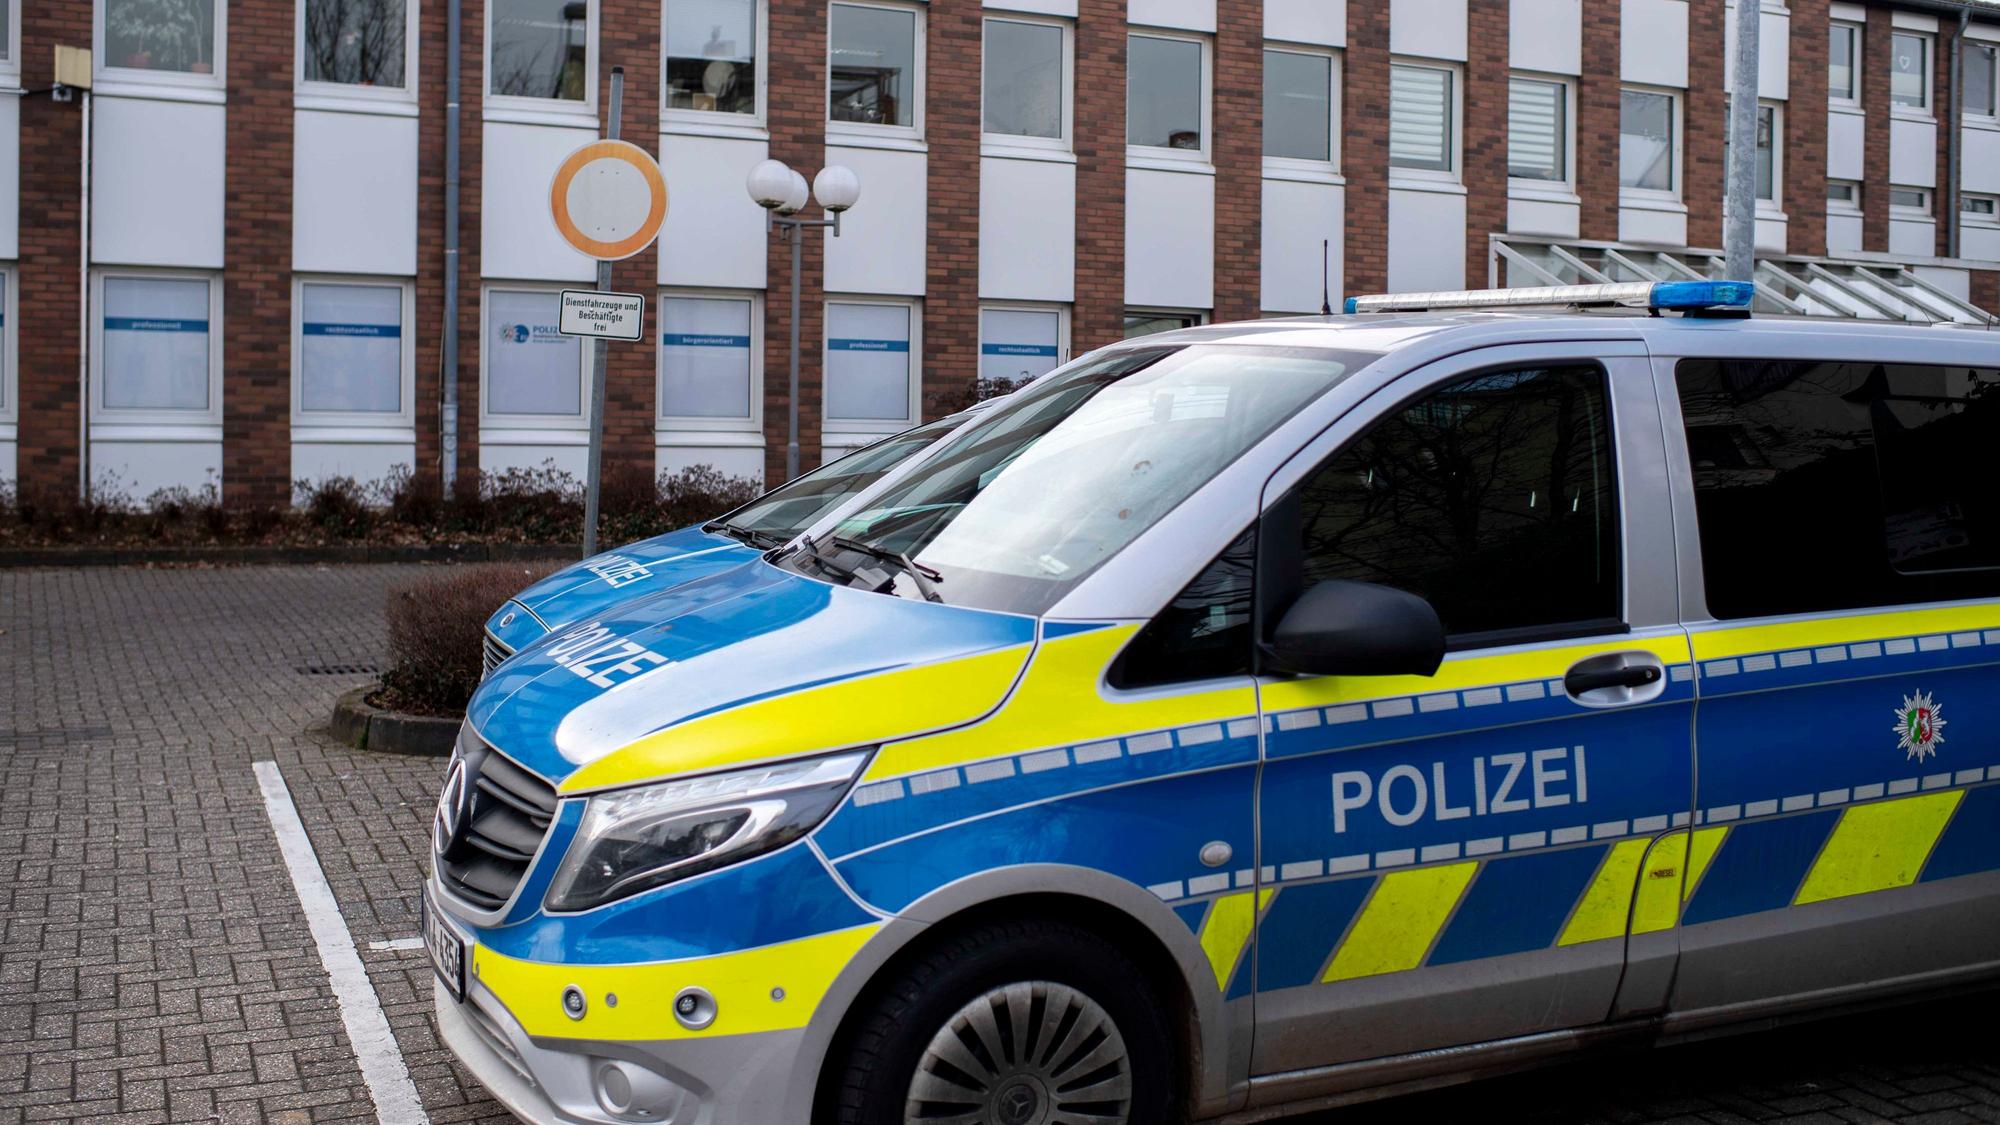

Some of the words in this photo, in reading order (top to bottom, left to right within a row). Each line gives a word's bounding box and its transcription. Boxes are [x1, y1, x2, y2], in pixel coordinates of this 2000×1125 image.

[566, 297, 623, 311] Dienstfahrzeuge
[624, 302, 638, 311] und
[579, 310, 623, 323] Beschäftigte
[533, 326, 559, 334] POLIZ
[594, 322, 607, 331] frei
[1332, 745, 1588, 833] POLIZEI
